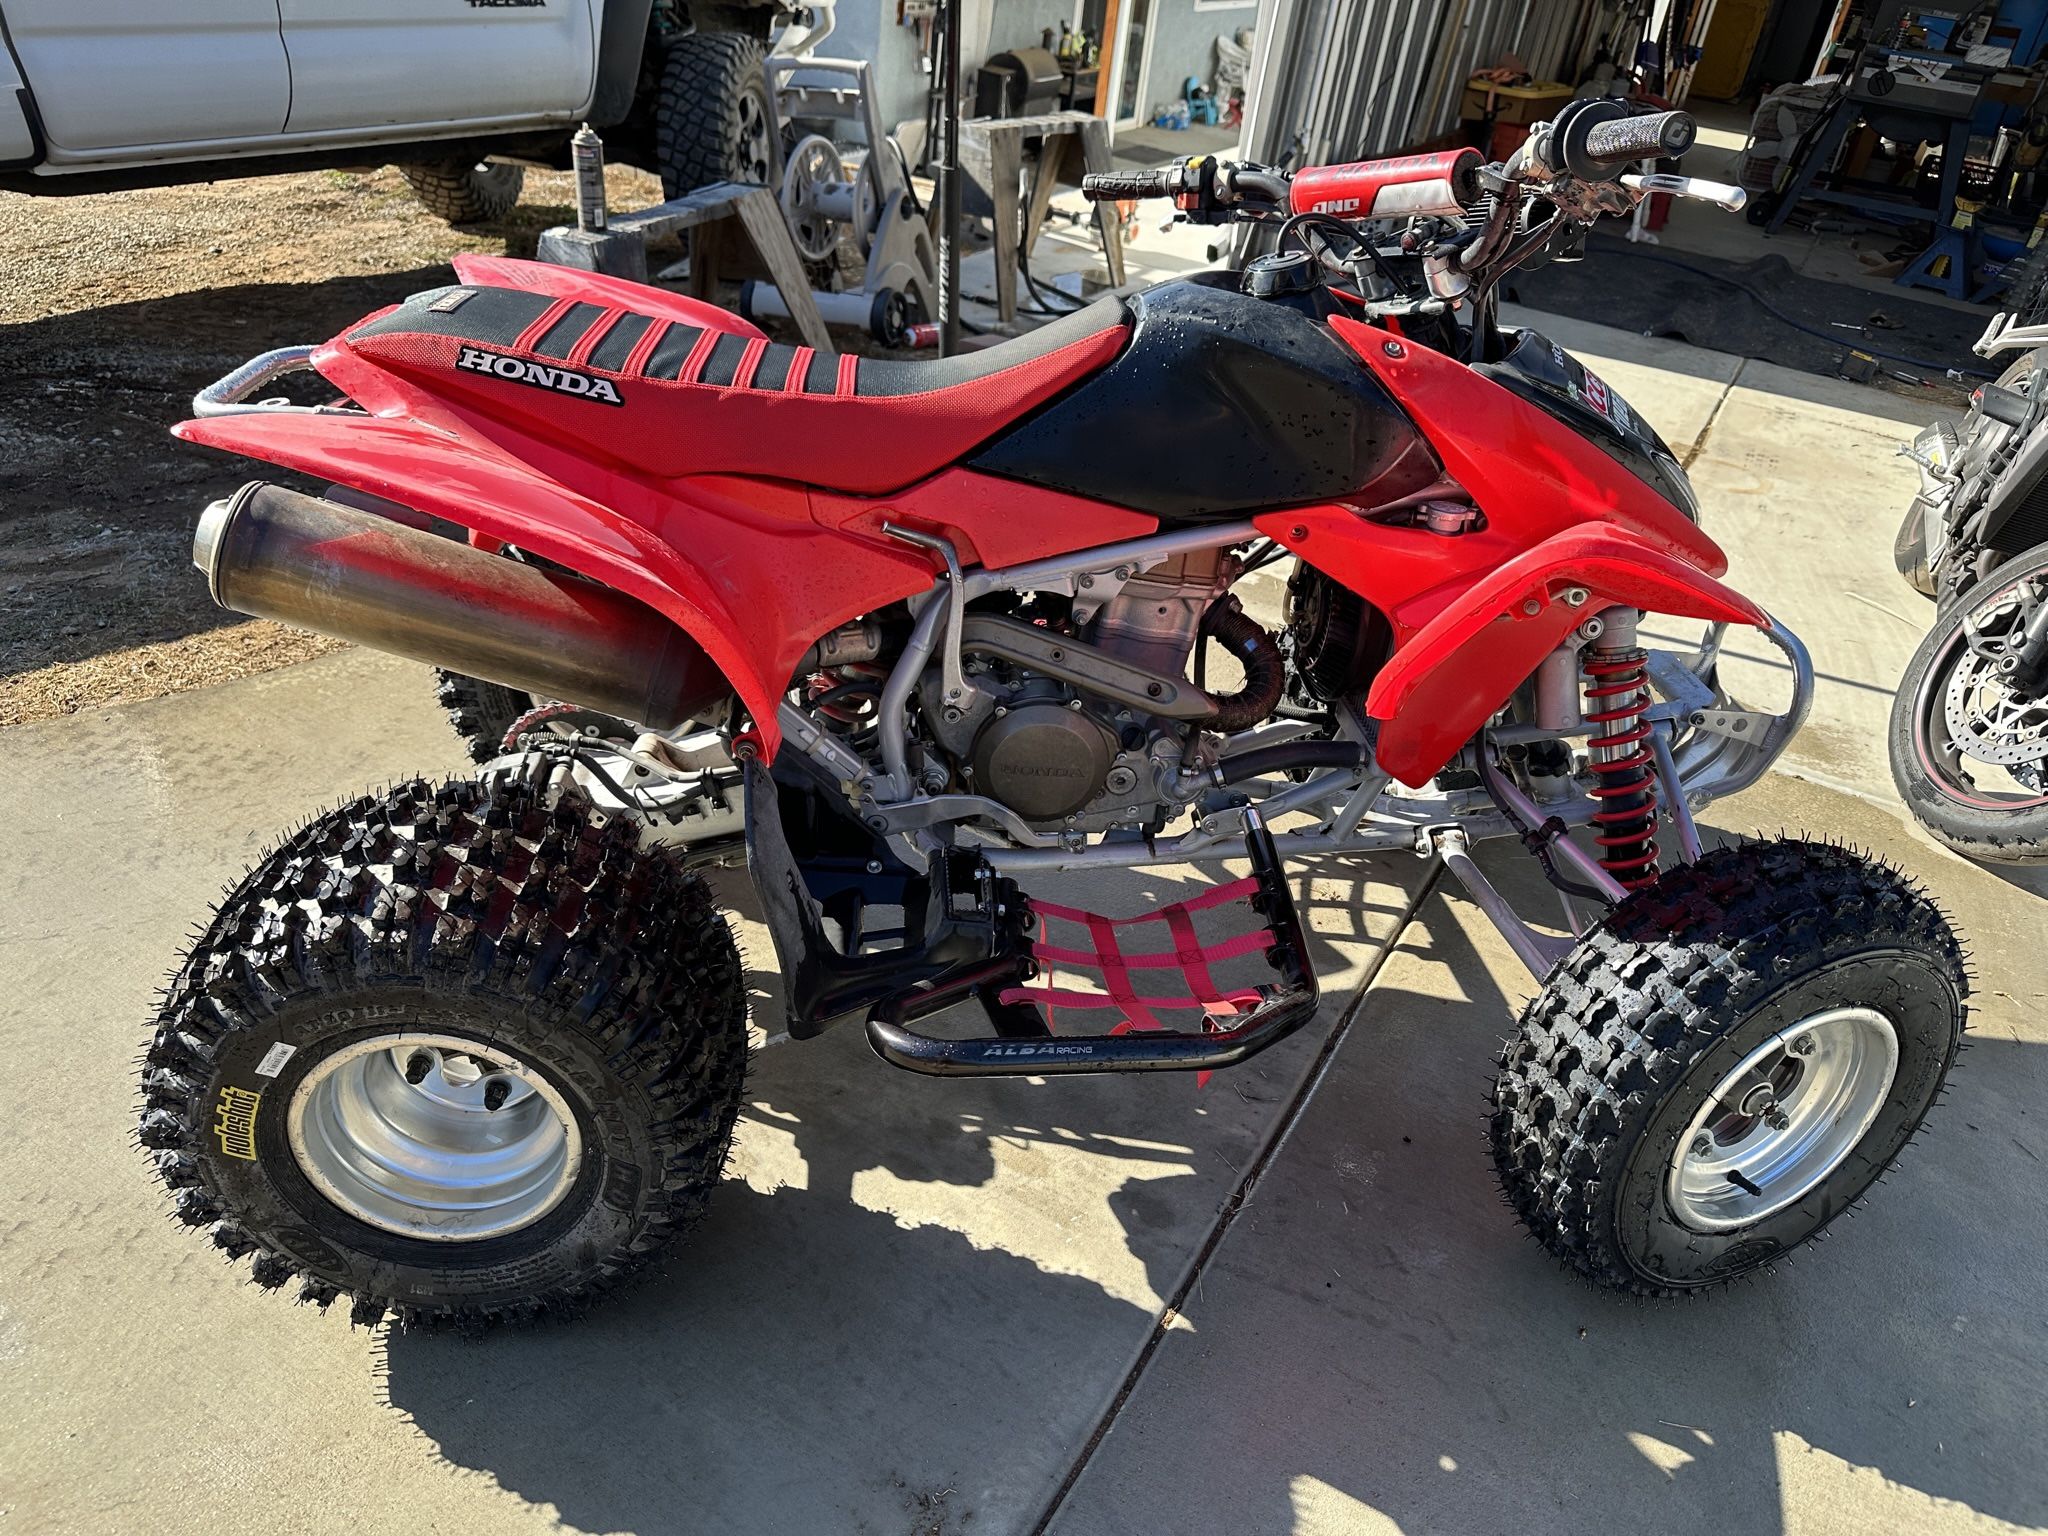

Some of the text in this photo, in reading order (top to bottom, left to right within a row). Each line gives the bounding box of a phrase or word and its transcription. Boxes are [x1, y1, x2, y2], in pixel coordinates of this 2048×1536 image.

[458, 348, 621, 403] HONDA
[1001, 763, 1085, 778] HONDA
[1056, 1046, 1093, 1055] RACING
